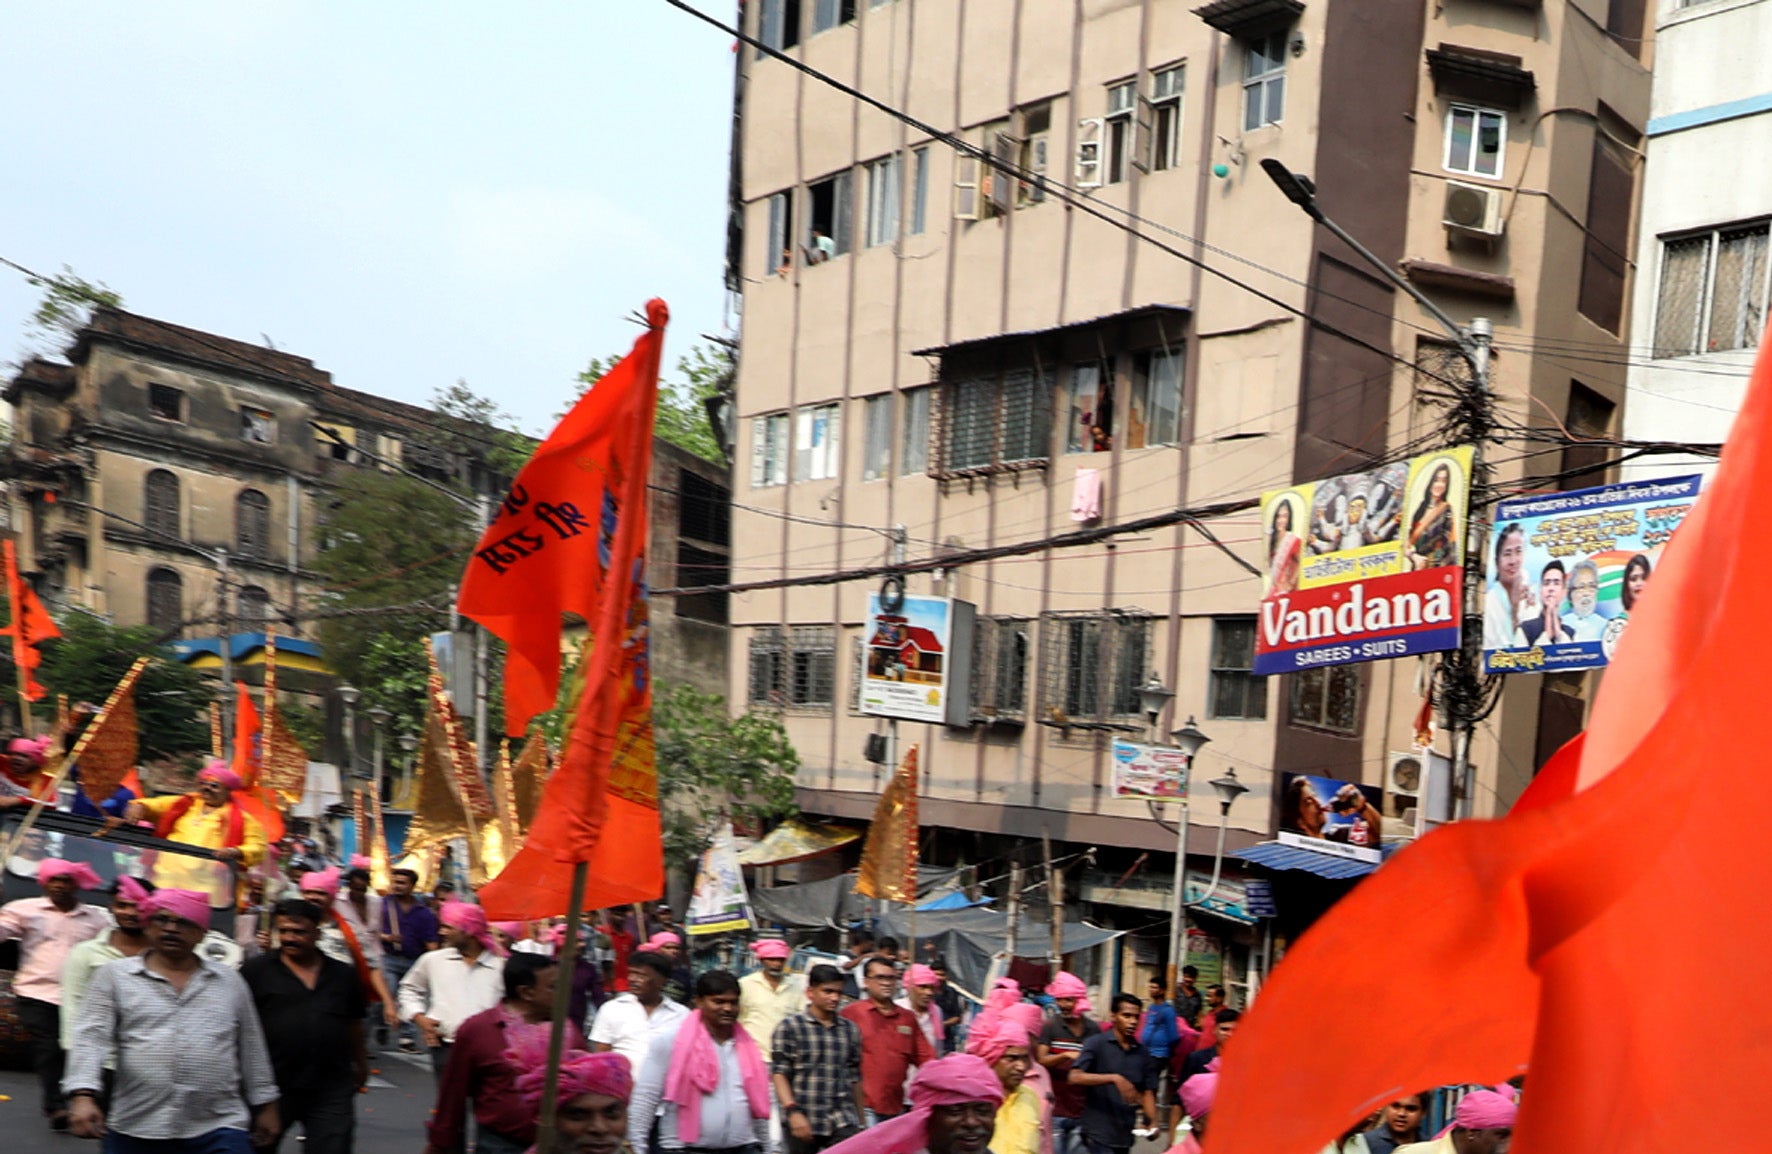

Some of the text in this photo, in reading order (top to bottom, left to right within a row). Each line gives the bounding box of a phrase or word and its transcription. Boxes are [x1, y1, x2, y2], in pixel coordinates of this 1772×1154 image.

[1262, 584, 1453, 647] Vandana
[1295, 639, 1407, 666] SAREES SUITS
